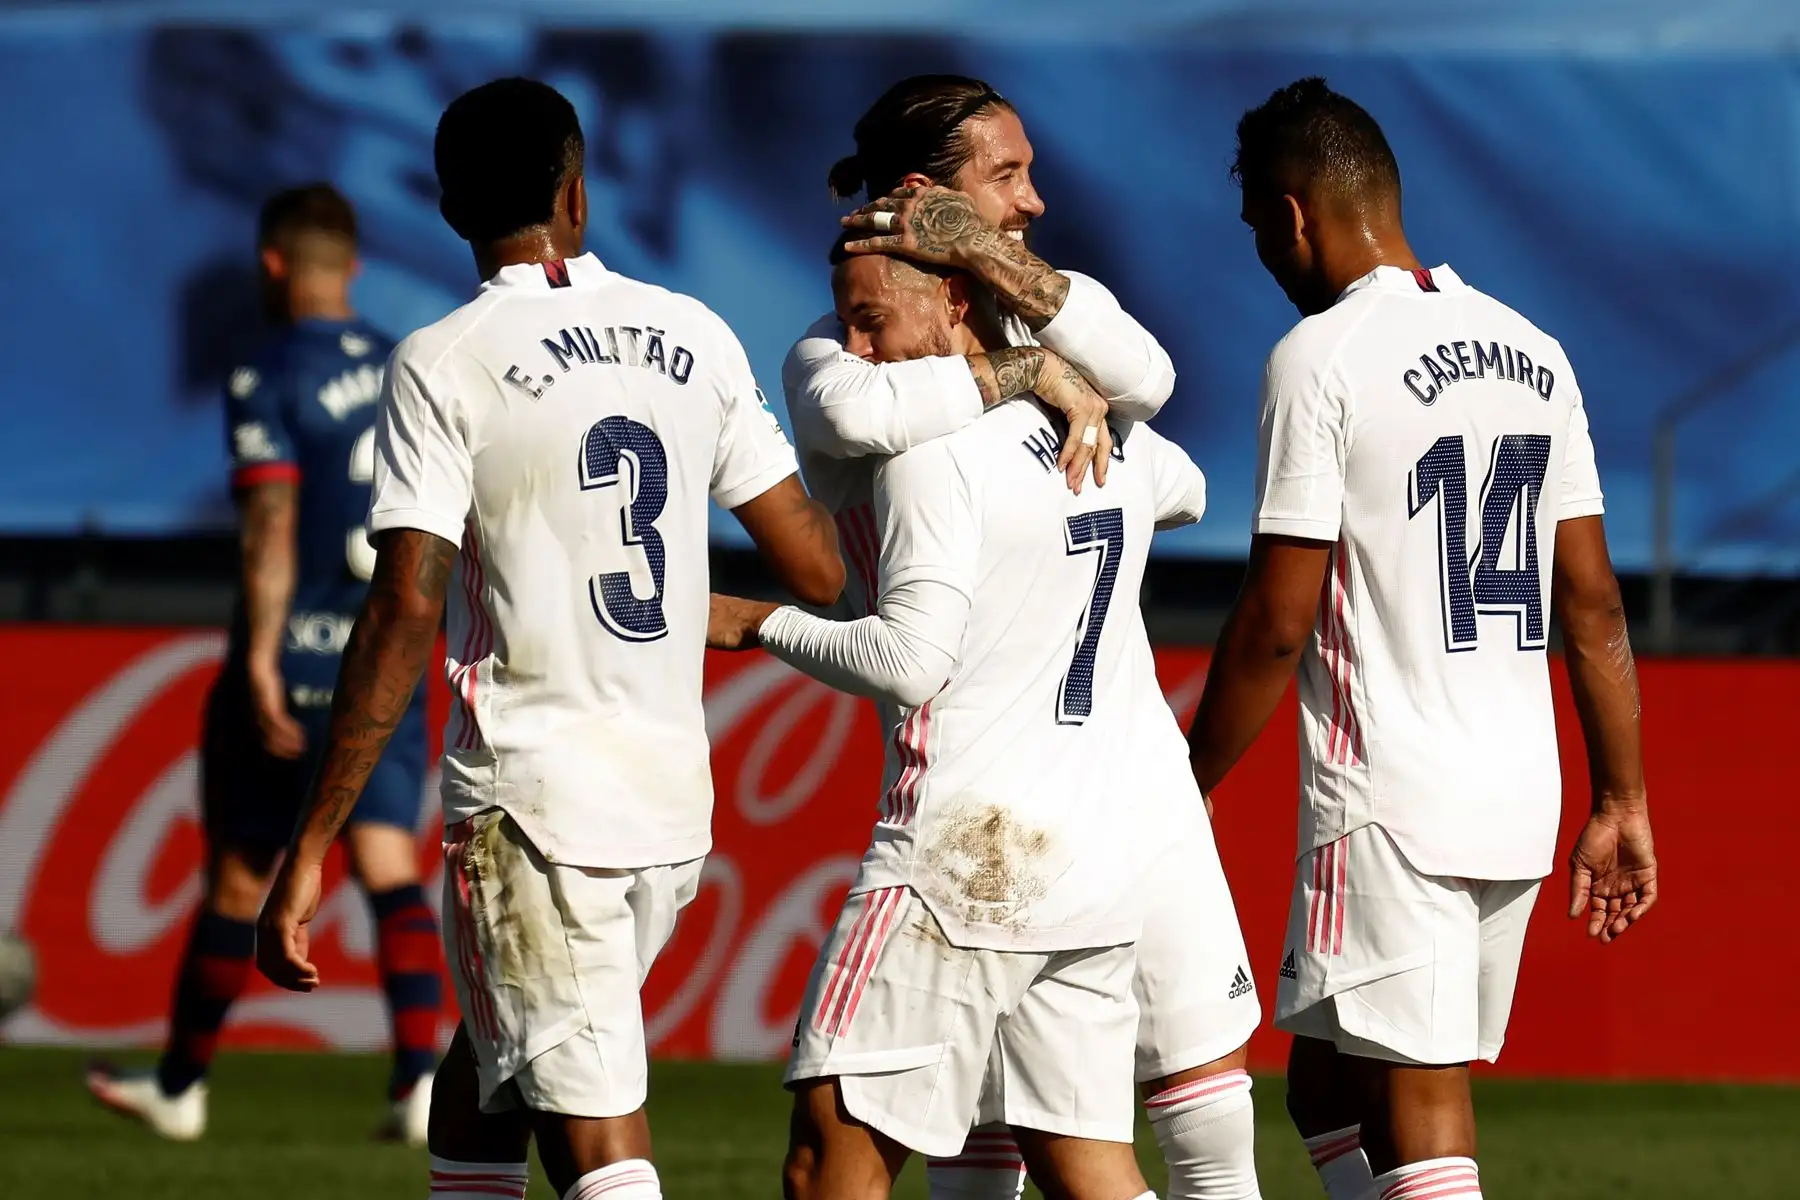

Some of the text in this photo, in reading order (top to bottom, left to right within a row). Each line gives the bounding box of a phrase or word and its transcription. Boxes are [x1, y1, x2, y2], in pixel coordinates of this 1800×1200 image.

[502, 326, 695, 403] E. MILITÃO
[1403, 340, 1555, 407] CASEMIRO
[578, 415, 669, 643] 3
[1407, 434, 1551, 654] 14
[1055, 507, 1124, 726] 7
[1228, 982, 1253, 999] adidas
